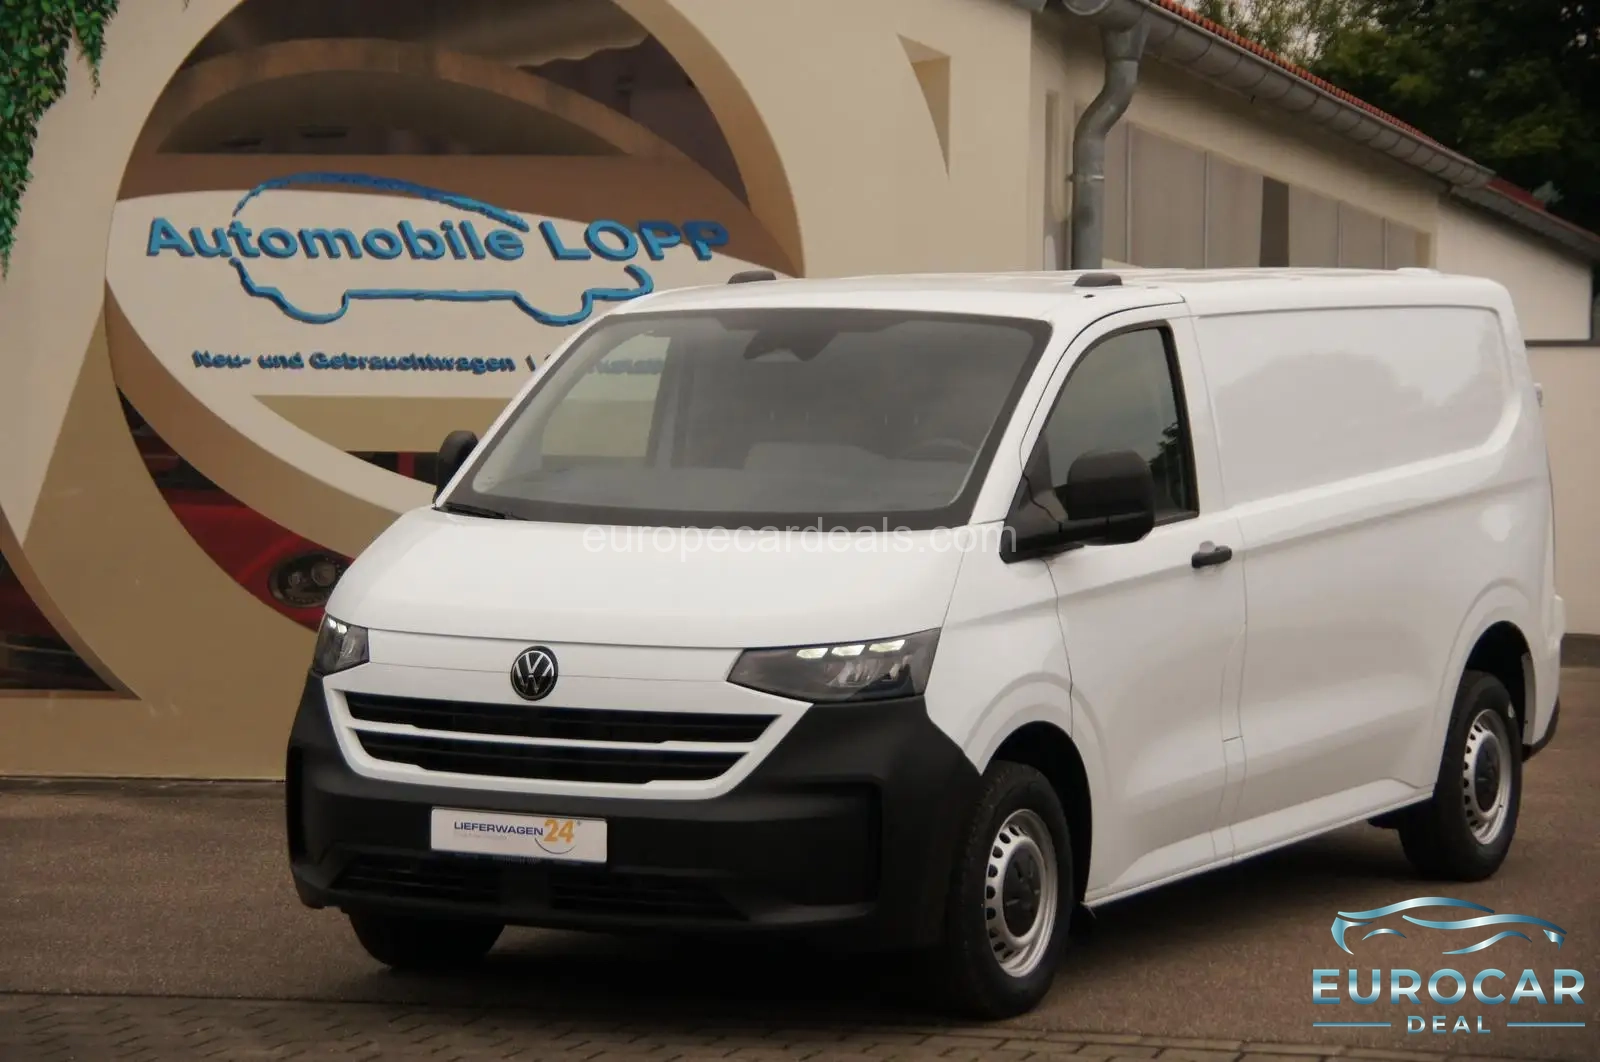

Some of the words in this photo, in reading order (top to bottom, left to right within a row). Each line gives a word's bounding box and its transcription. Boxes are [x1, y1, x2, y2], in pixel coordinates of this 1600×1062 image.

[146, 217, 525, 260] Automobile
[538, 219, 729, 261] LOPP
[191, 350, 251, 369] Neu-
[257, 352, 305, 369] und
[309, 352, 516, 375] Gebrauchtwagen
